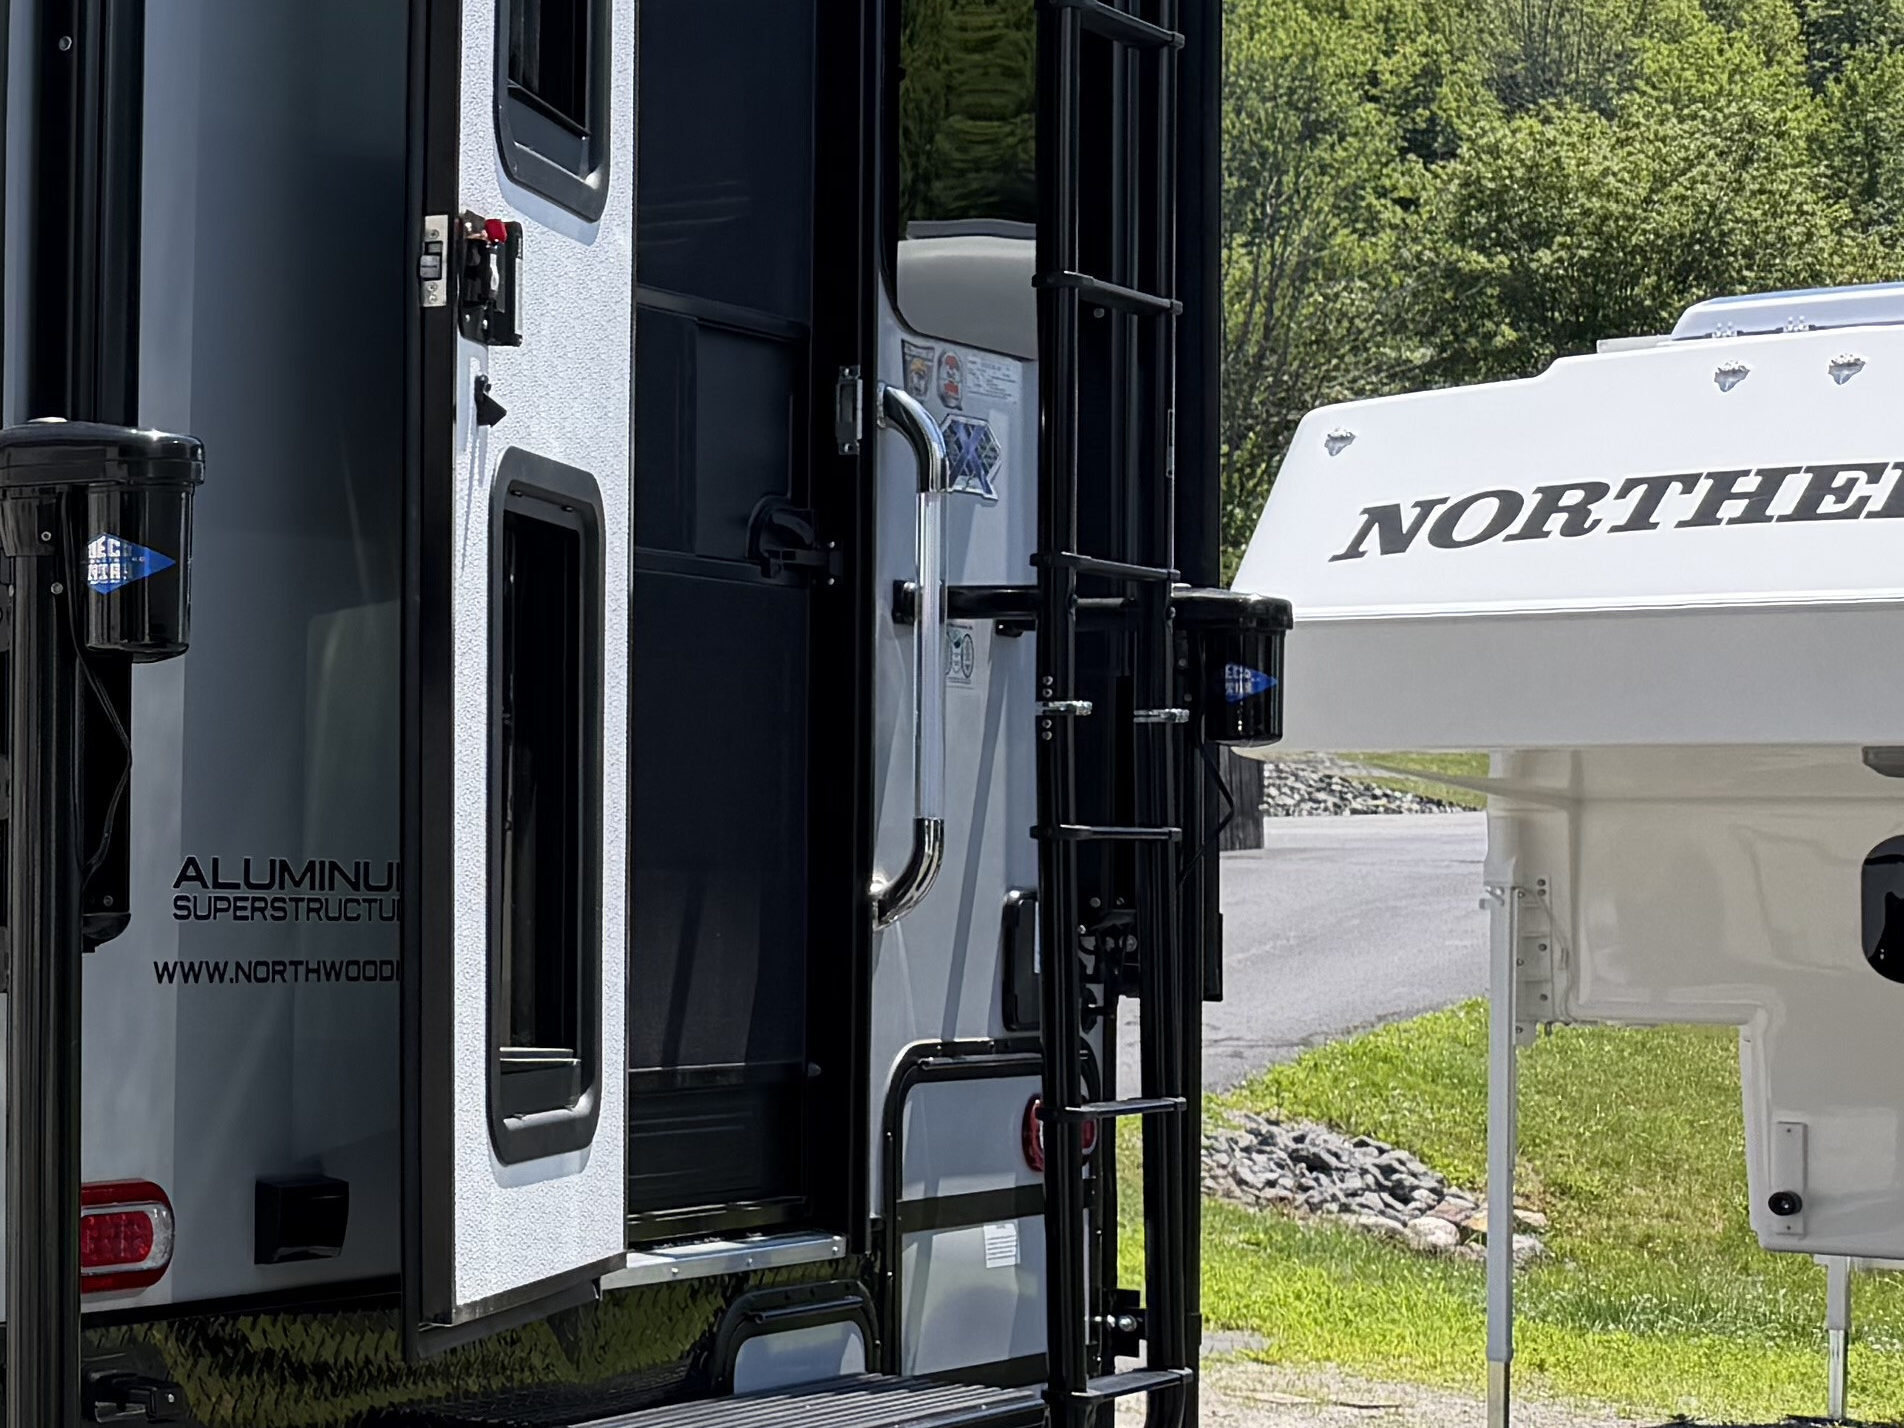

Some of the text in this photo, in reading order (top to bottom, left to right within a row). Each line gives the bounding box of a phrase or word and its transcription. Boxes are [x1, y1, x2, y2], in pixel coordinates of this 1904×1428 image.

[1328, 460, 1904, 562] NORTHE
[172, 856, 401, 892] ALUMINU
[172, 894, 401, 922] SUPERSTRUCTU
[153, 959, 401, 984] WWW.NORTHWOOD
